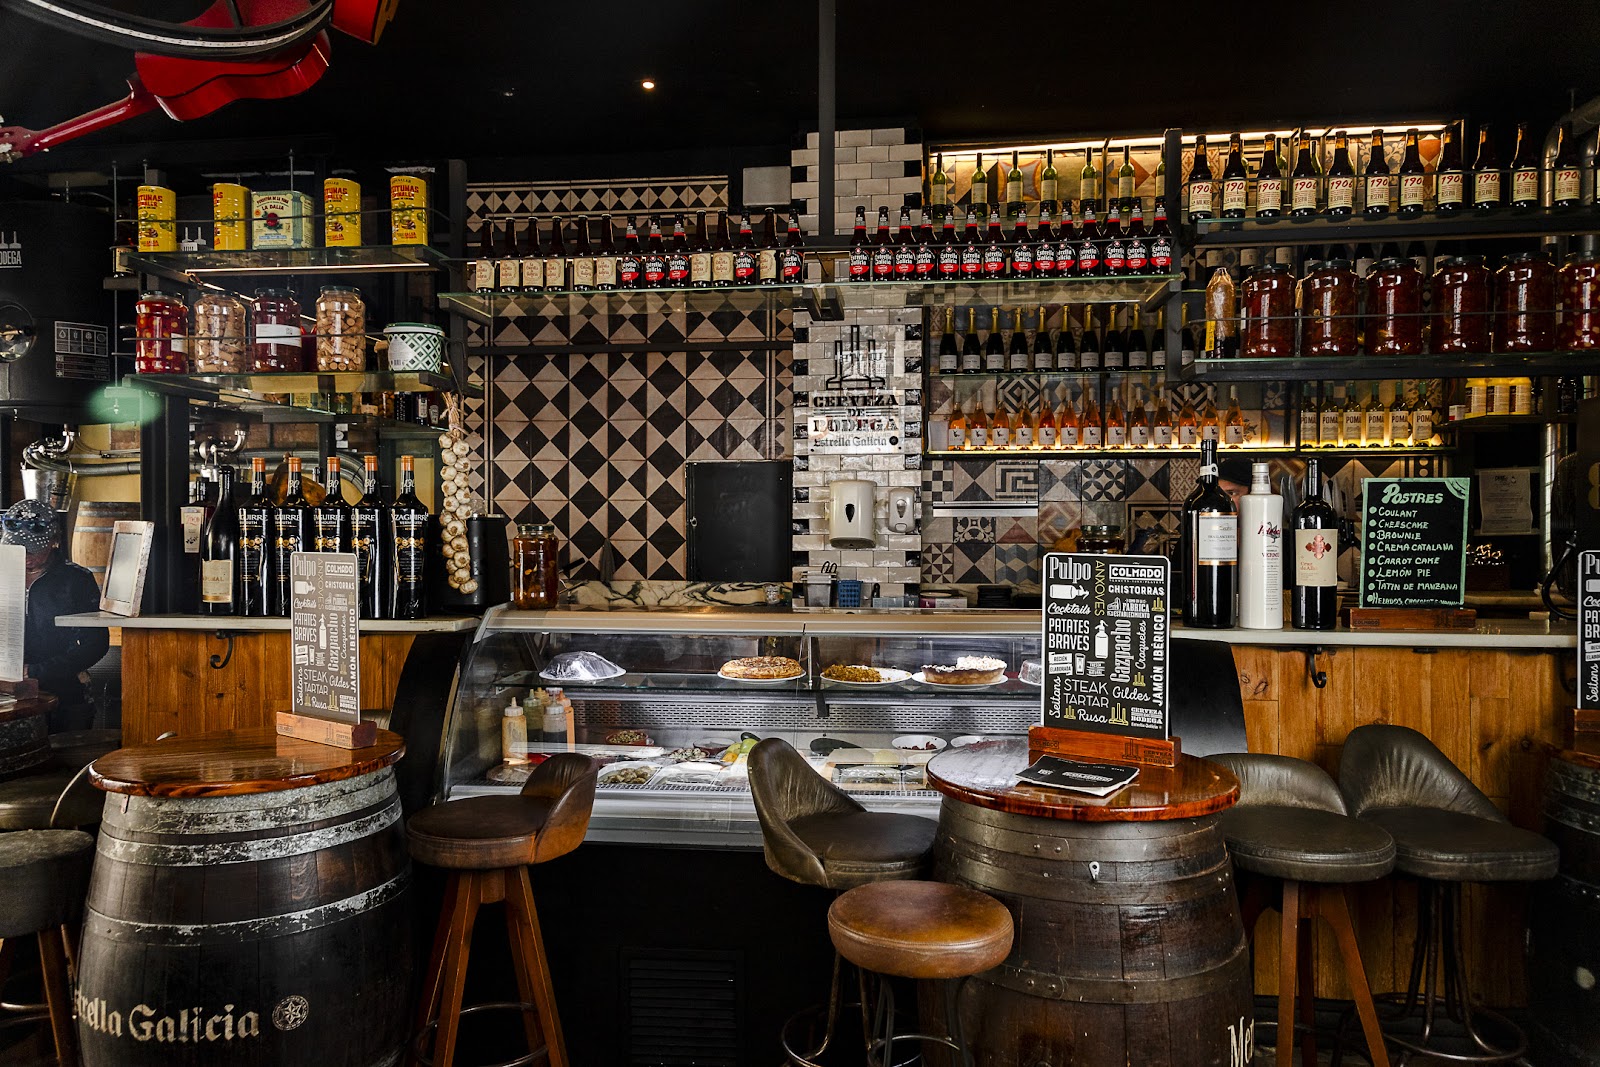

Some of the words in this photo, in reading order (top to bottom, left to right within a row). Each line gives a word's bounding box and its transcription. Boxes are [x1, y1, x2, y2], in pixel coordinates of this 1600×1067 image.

[1258, 182, 1280, 192] 1906
[813, 394, 898, 406] CERVEZA
[848, 409, 865, 417] DE
[814, 437, 850, 447] Estrella
[852, 437, 887, 446] Galicia
[1381, 483, 1444, 504] POSTRES
[1378, 507, 1418, 518] COULANT
[1376, 530, 1421, 540] BROWNIE
[1377, 541, 1410, 552] CREMA
[1412, 543, 1453, 551] CATALANA
[294, 555, 317, 579] Pulpo
[1377, 555, 1412, 565] CARROT
[326, 564, 353, 574] COLMADO
[1049, 557, 1091, 583] Pulpo
[1112, 567, 1161, 578] COLMADO
[1417, 569, 1431, 577] PIE
[325, 581, 355, 590] CHISTORRAS
[1095, 560, 1105, 616] ANXOVES
[1108, 584, 1165, 596] CHISTORRAS
[1376, 579, 1400, 590] TATIN
[294, 598, 317, 609] Cocktails
[1047, 602, 1091, 615] Cocktails
[295, 612, 317, 626] PATATES
[1049, 618, 1090, 634] PATATES
[295, 626, 317, 643] BRAVES
[1585, 623, 1600, 638] BR
[327, 612, 339, 672] Gazpacho
[1049, 634, 1090, 651] BRAVES
[1135, 620, 1149, 670] Croquetes
[1151, 614, 1165, 662] IBÉRICO
[1109, 619, 1135, 683] Gazpacho
[304, 669, 328, 683] STEAK
[348, 656, 356, 693] JAMÓN
[304, 682, 328, 695] TARTAR
[330, 675, 350, 689] Gildes
[1063, 678, 1109, 695] STEAK
[1150, 666, 1163, 707] JAMÓN
[1586, 663, 1599, 702] Seitons
[1049, 676, 1062, 718] Seitons
[1064, 692, 1109, 709] TARTAR
[1112, 686, 1151, 702] Gildes
[311, 696, 328, 710] Rusa
[1077, 708, 1108, 723] Rusa
[74, 988, 123, 1037] trella
[129, 1004, 260, 1043] Galicia
